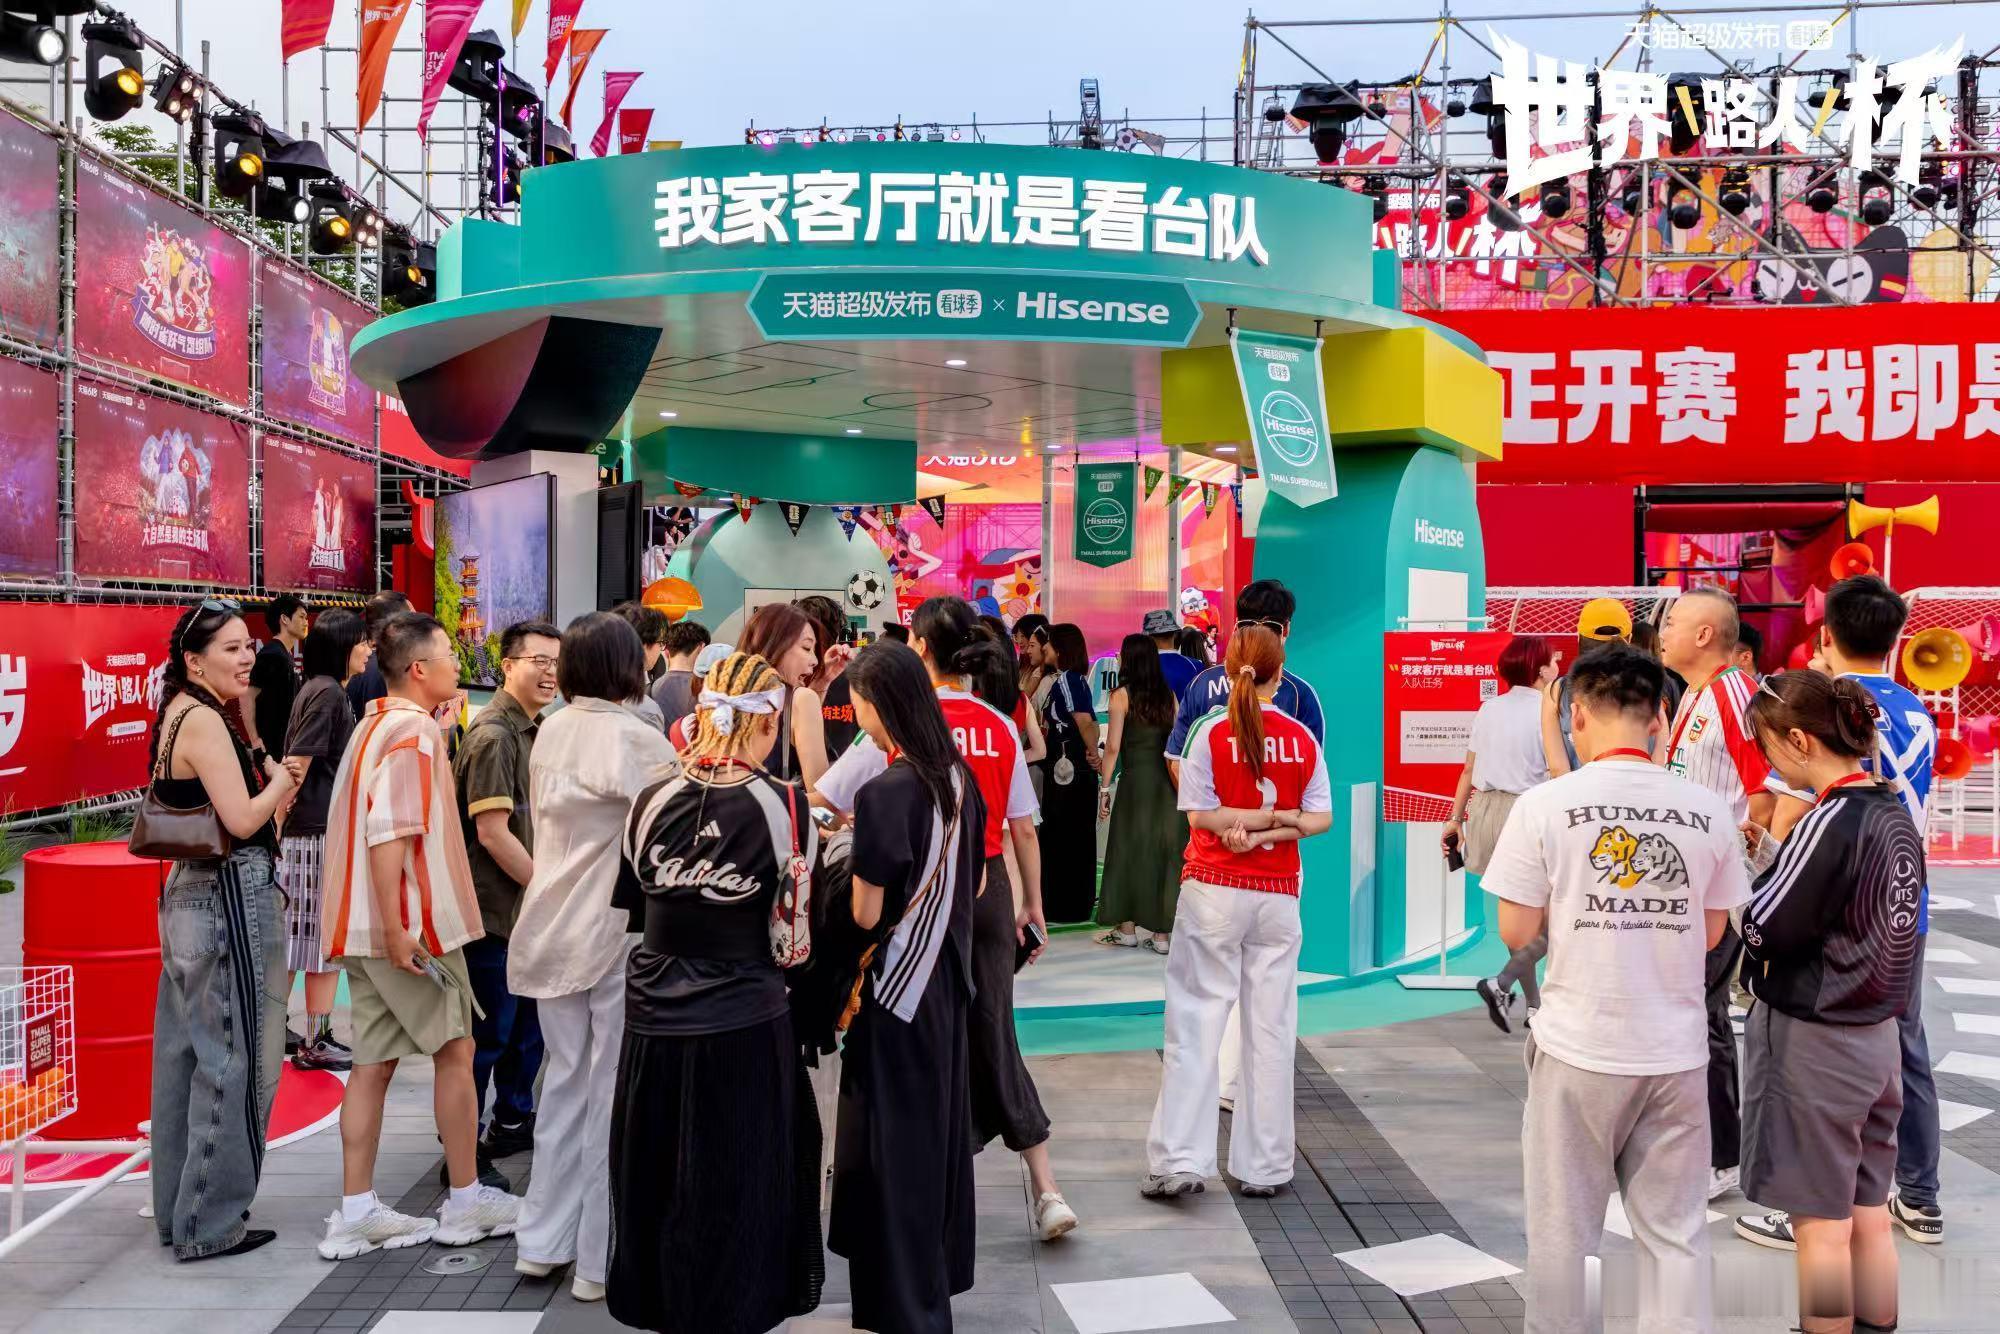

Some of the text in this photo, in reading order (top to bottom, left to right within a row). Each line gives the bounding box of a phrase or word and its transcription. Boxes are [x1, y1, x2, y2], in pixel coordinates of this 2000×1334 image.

[654, 169, 1269, 266] 我家客厅就是看台队
[783, 291, 931, 319] 天猫超级发布
[940, 294, 980, 314] 看球季
[1016, 291, 1170, 325] Hisense
[1265, 418, 1315, 437] Hisense
[1270, 473, 1290, 484] TMALL
[1290, 476, 1310, 487] SUPER
[1086, 517, 1125, 525] Hisense
[1415, 518, 1464, 548] Hisense
[1401, 664, 1495, 676] 我家客厅就是看台队
[1101, 671, 1117, 690] 10
[1401, 678, 1443, 689] 入队任务
[1227, 736, 1305, 764] TALL
[1565, 805, 1711, 834] HUMAN
[1895, 888, 1913, 901] NTS
[1585, 894, 1689, 915] MADE
[1574, 919, 1600, 931] Gears
[1603, 919, 1618, 931] for
[30, 1023, 51, 1040] TMALL
[30, 1034, 52, 1051] SUPER
[30, 1045, 52, 1062] GOALS
